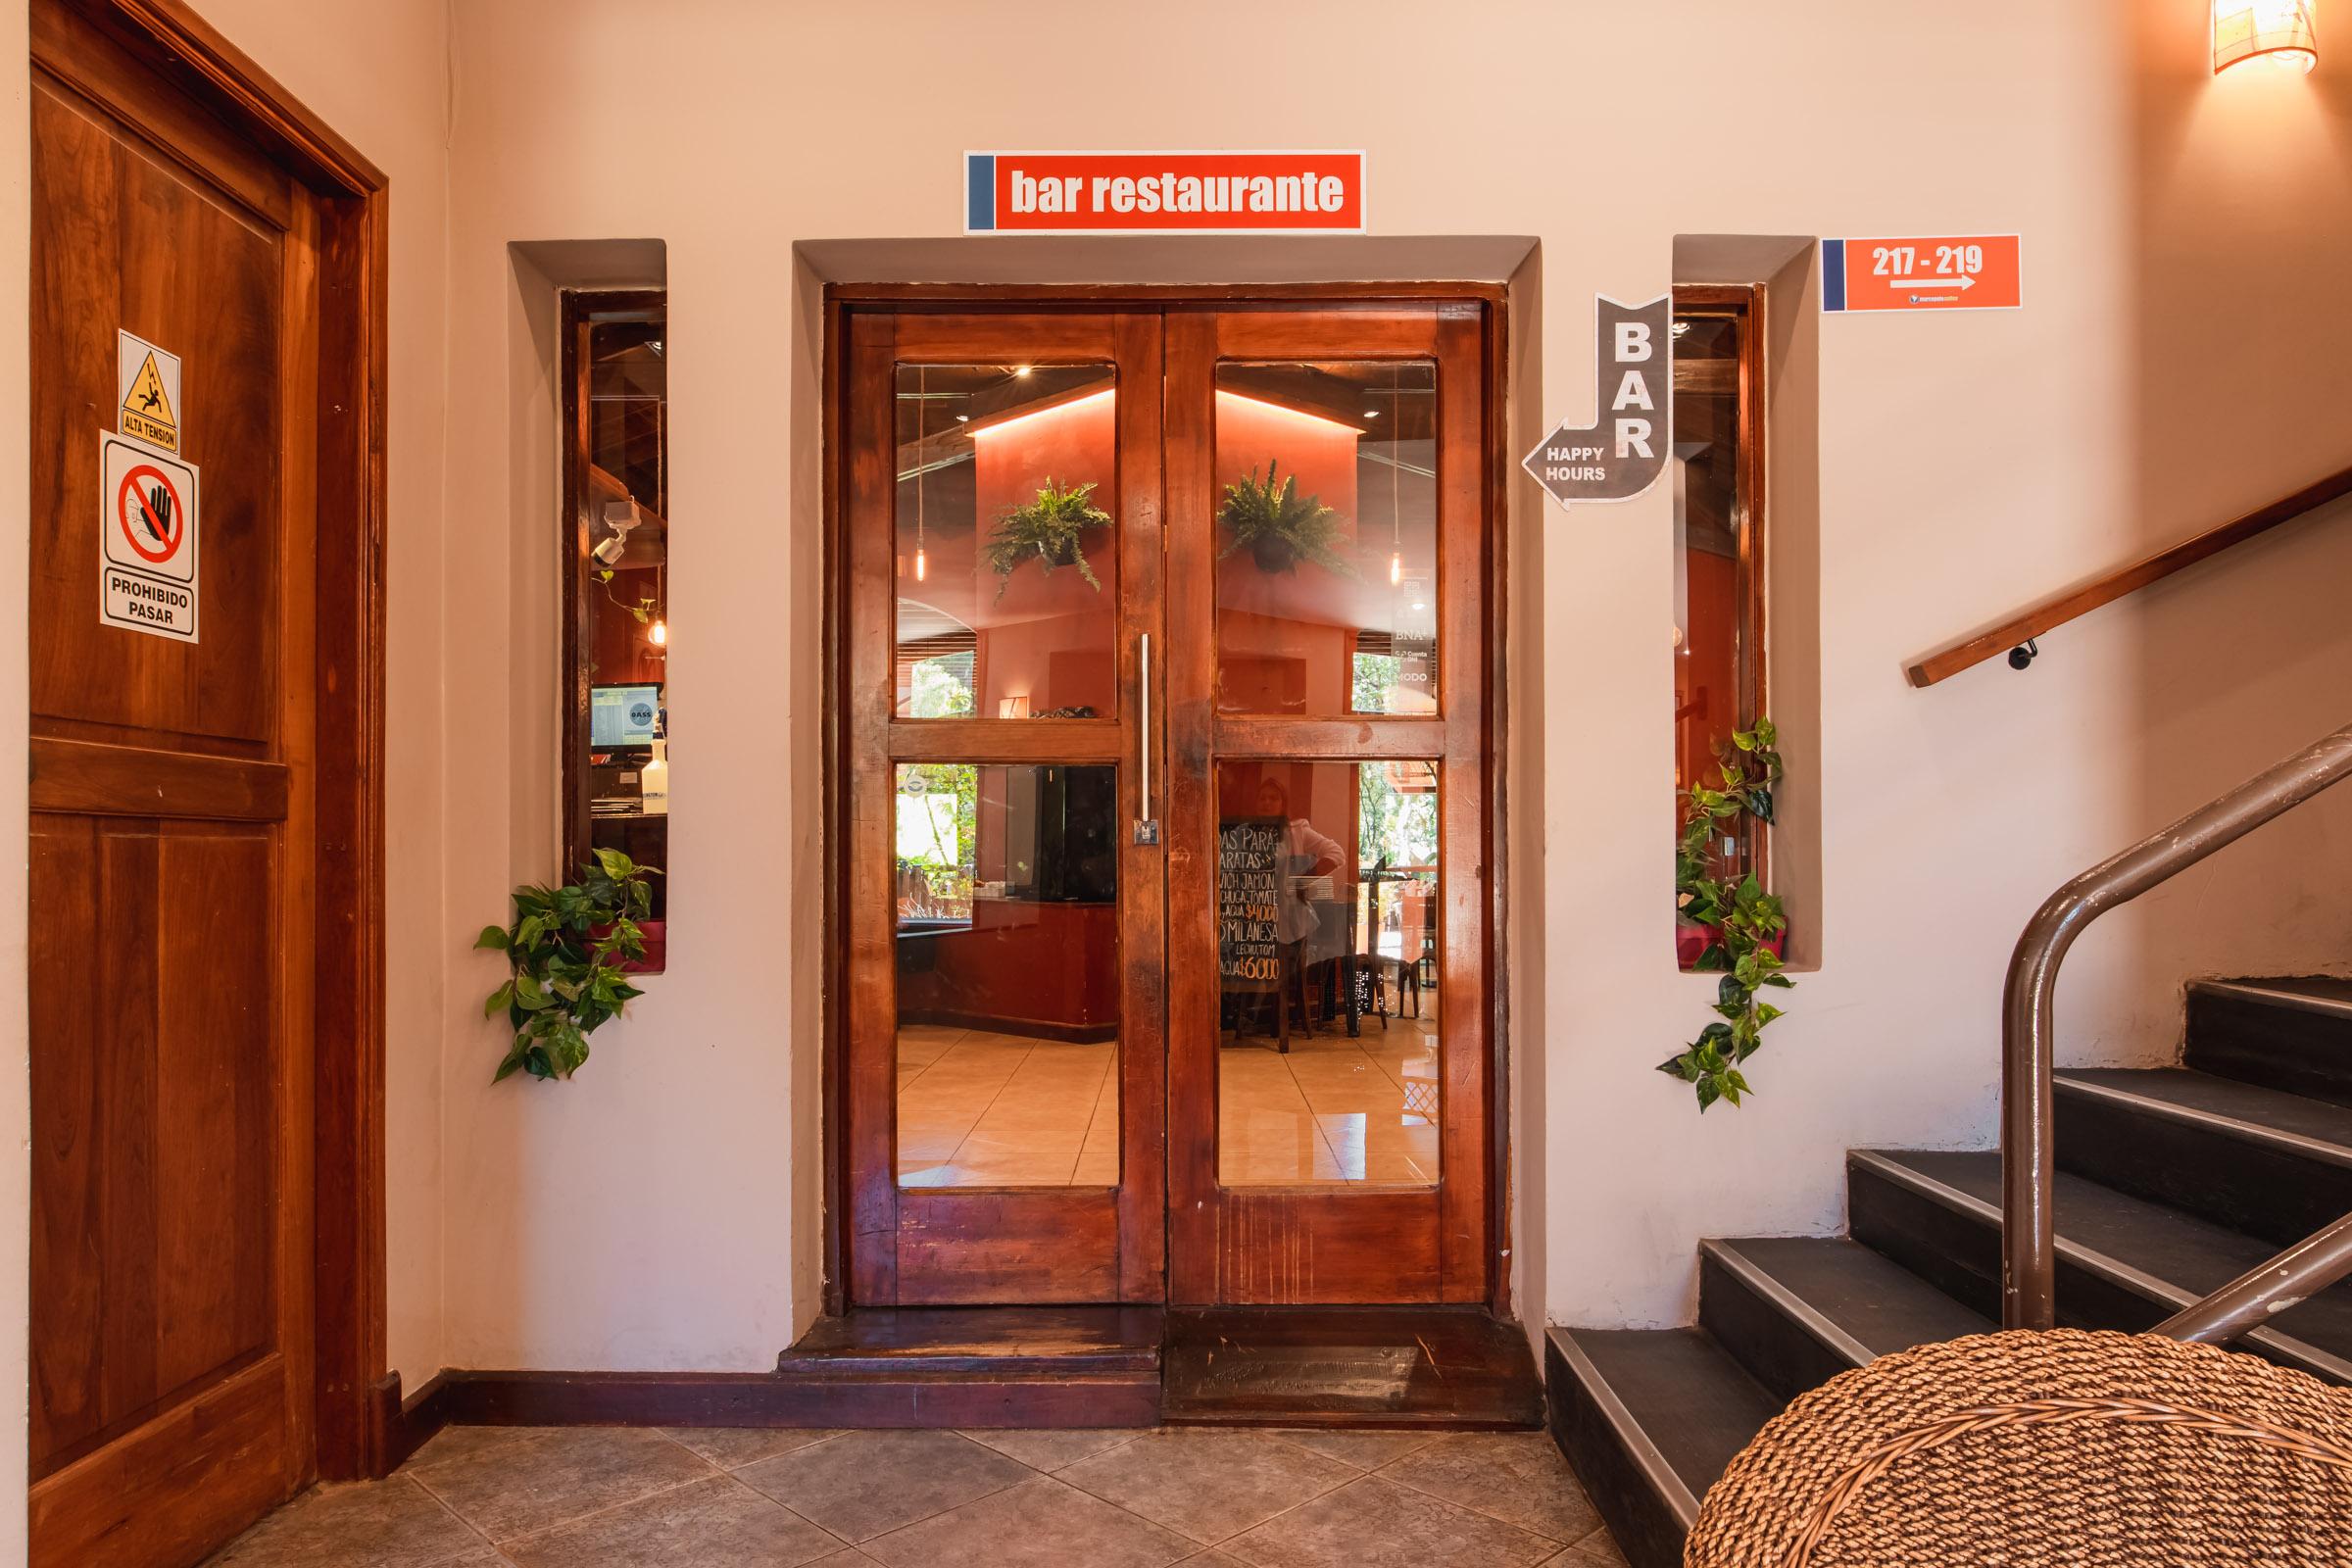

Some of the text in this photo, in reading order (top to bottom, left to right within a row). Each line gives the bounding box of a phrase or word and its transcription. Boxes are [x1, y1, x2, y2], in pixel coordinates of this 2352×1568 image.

[1011, 171, 1345, 213] bar restaurante
[1873, 246, 1915, 275] 217
[1936, 245, 1983, 273] 219
[1611, 321, 1655, 459] BAR
[124, 416, 174, 446] ALTA TENSION
[1546, 447, 1604, 462] HAPPY
[1545, 466, 1606, 481] HOURS
[112, 576, 187, 609] PROHIBIDO
[128, 601, 173, 625] PASAR
[1241, 872, 1275, 890] JAMON
[1227, 921, 1279, 942] MILANESA
